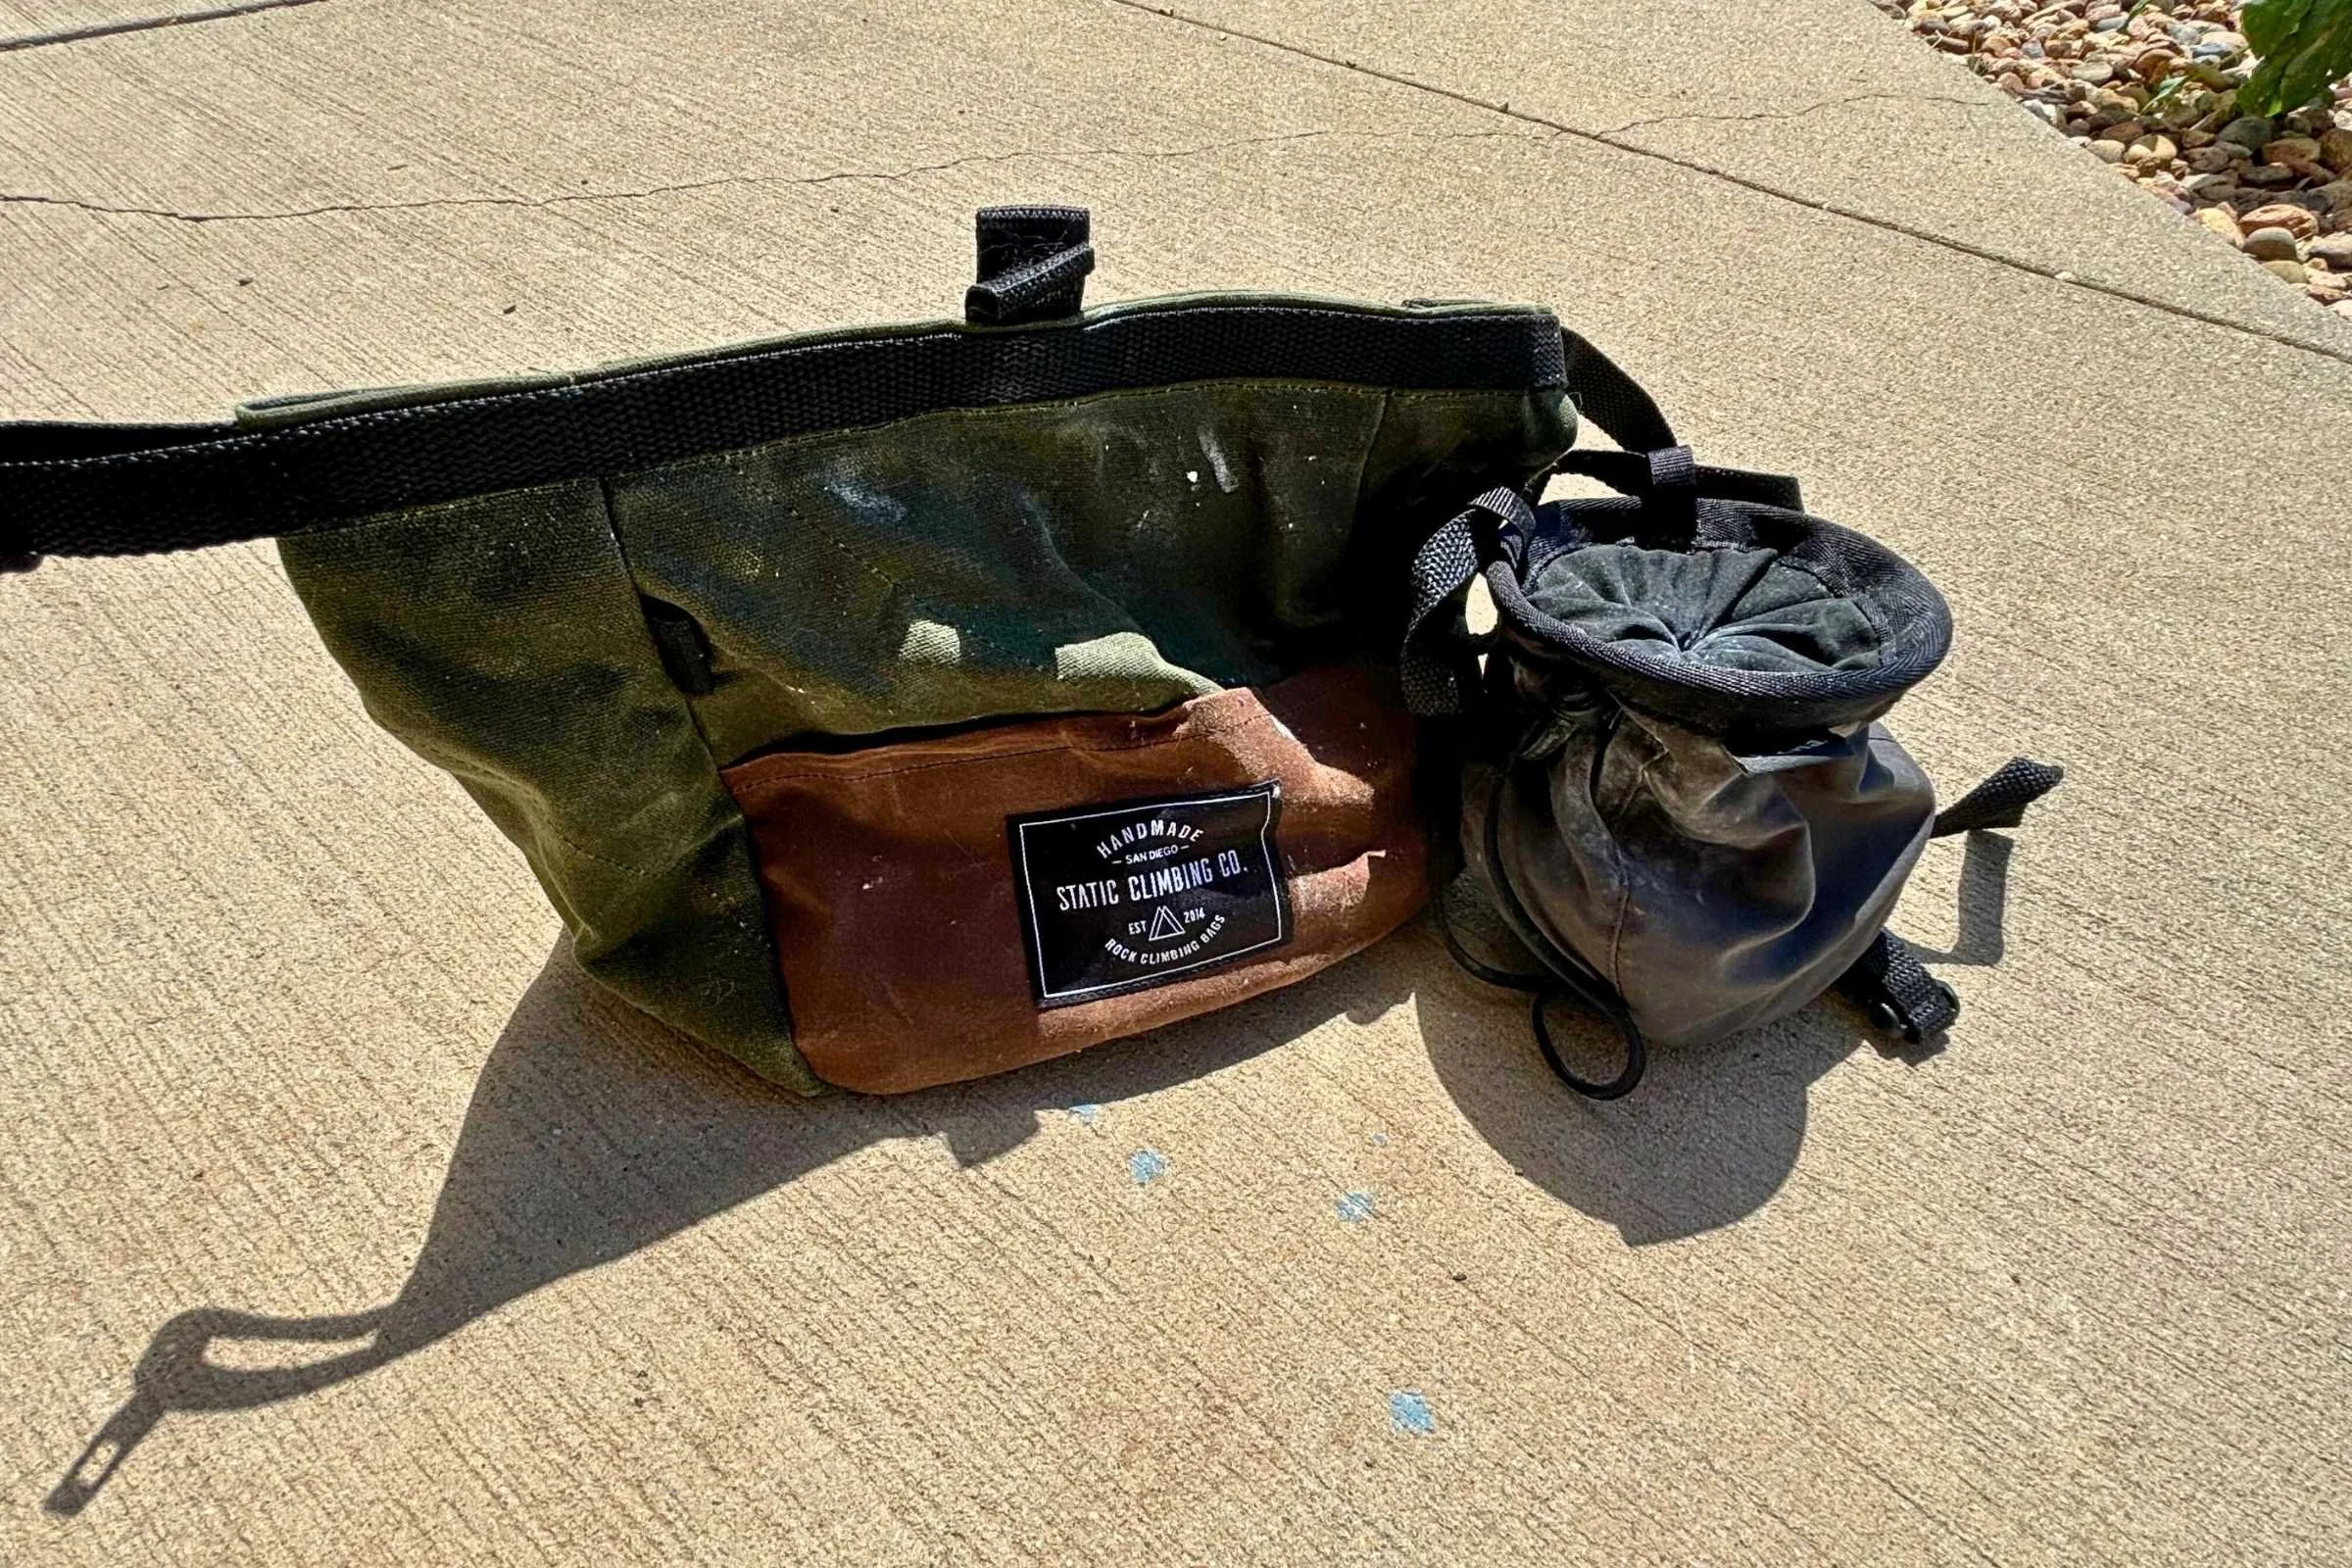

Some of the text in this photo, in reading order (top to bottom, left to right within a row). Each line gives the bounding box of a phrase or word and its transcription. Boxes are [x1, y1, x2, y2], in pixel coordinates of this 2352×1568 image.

[1096, 819, 1204, 858] HANDMADE
[1125, 845, 1179, 864] SAN DIEGO
[1055, 850, 1249, 911] STATIC CLIMBING CO.
[1104, 914, 1226, 965] ROCK CLIMBING BAGS
[1128, 906, 1205, 935] EST 2014
